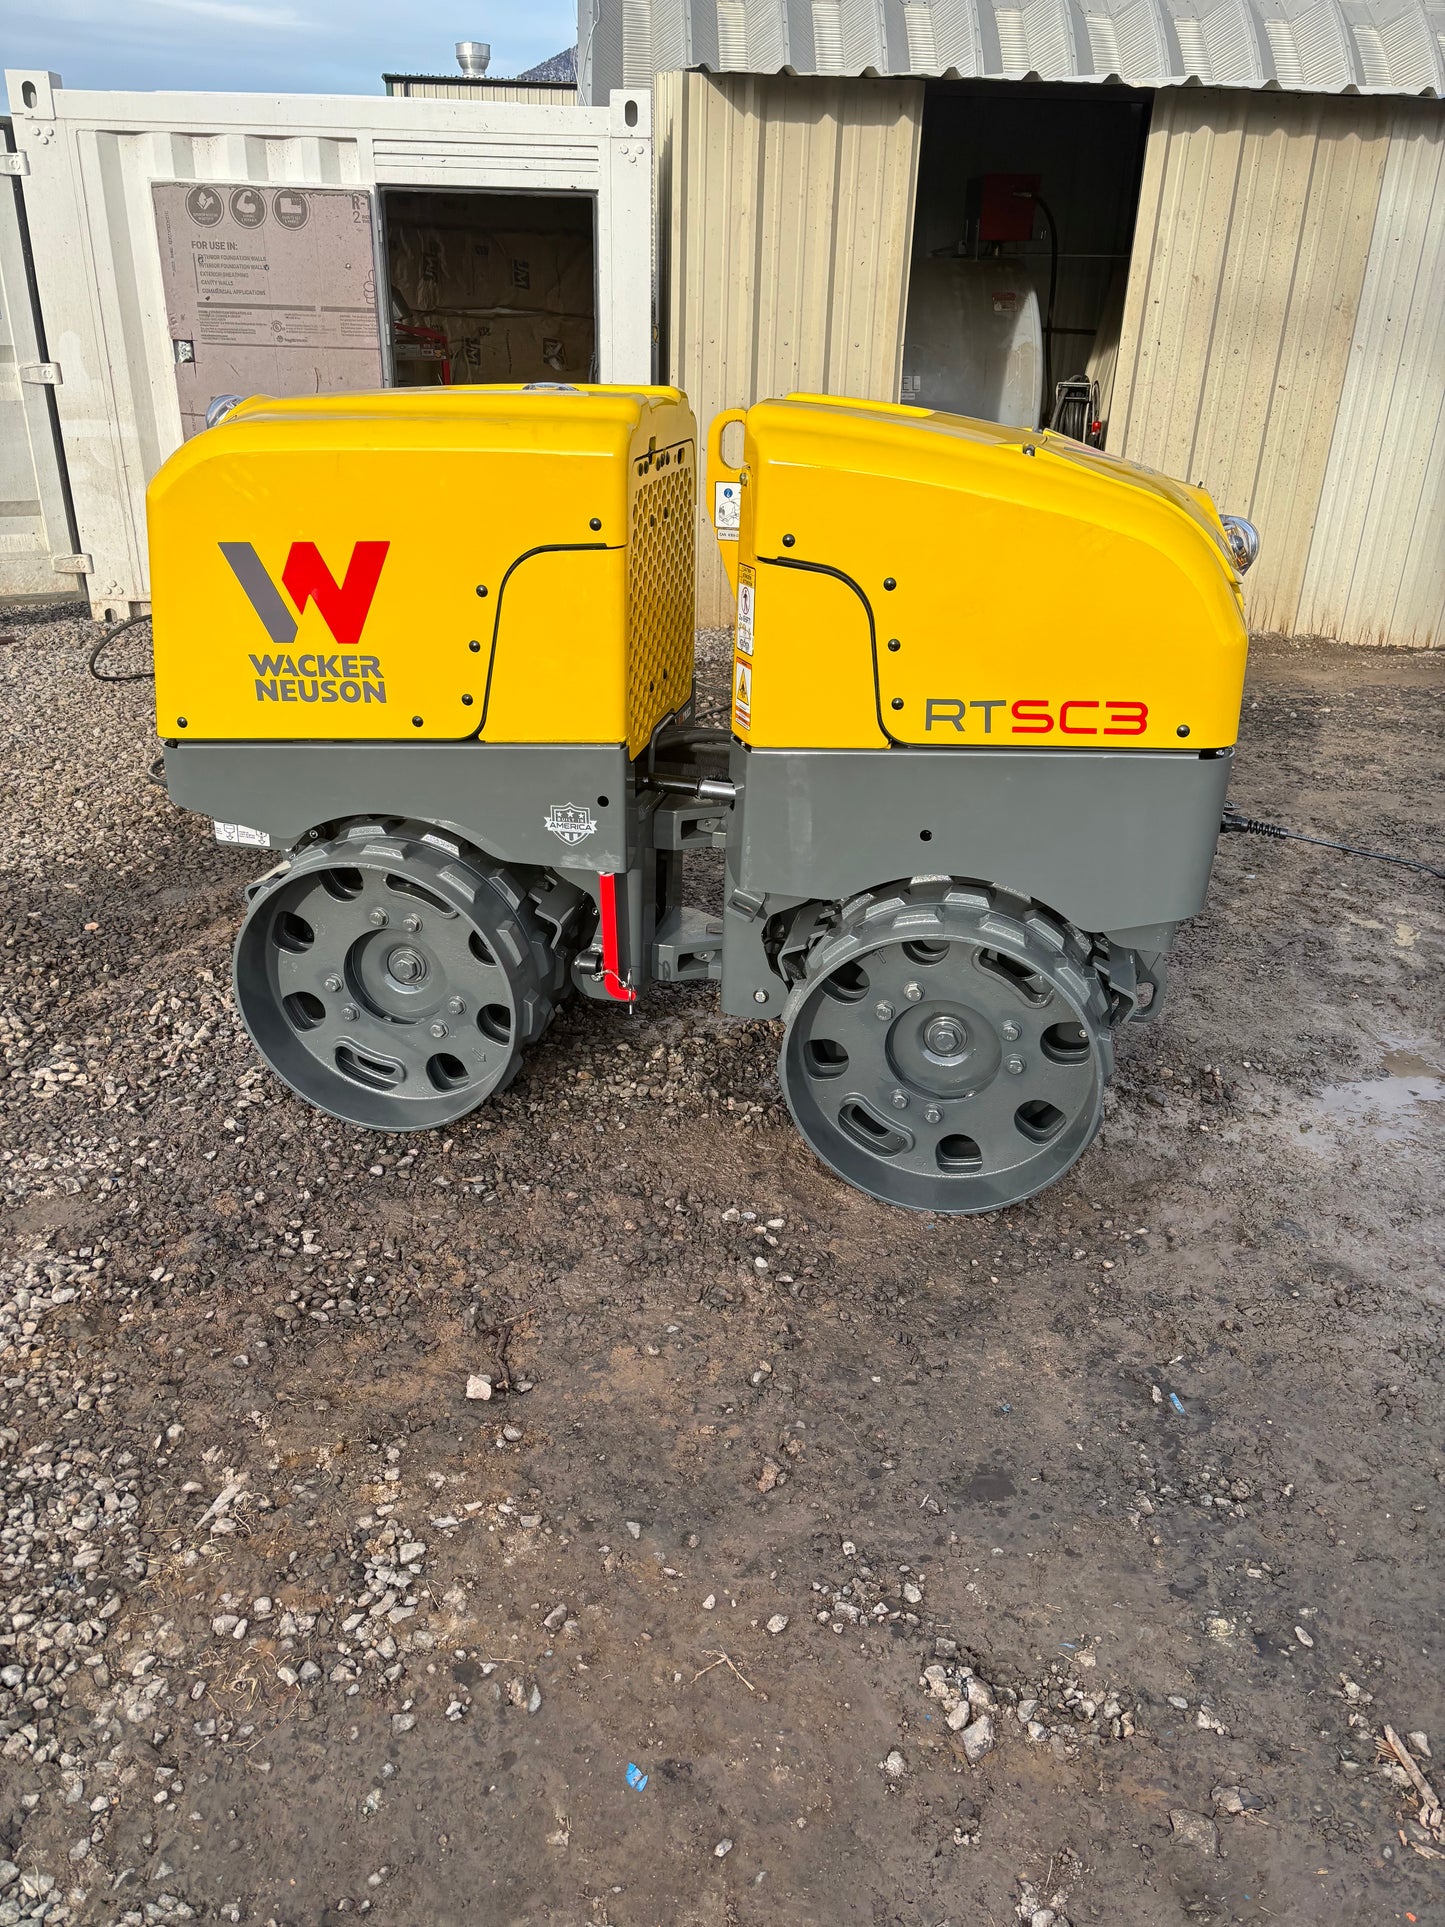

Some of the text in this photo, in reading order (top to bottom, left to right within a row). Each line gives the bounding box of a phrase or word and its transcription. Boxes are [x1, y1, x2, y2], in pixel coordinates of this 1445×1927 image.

[352, 211, 361, 223] 2
[191, 241, 239, 251] FOR USE IN:
[248, 654, 385, 679] WACKER
[255, 679, 387, 703] NEUSON
[550, 822, 592, 831] AMERICA
